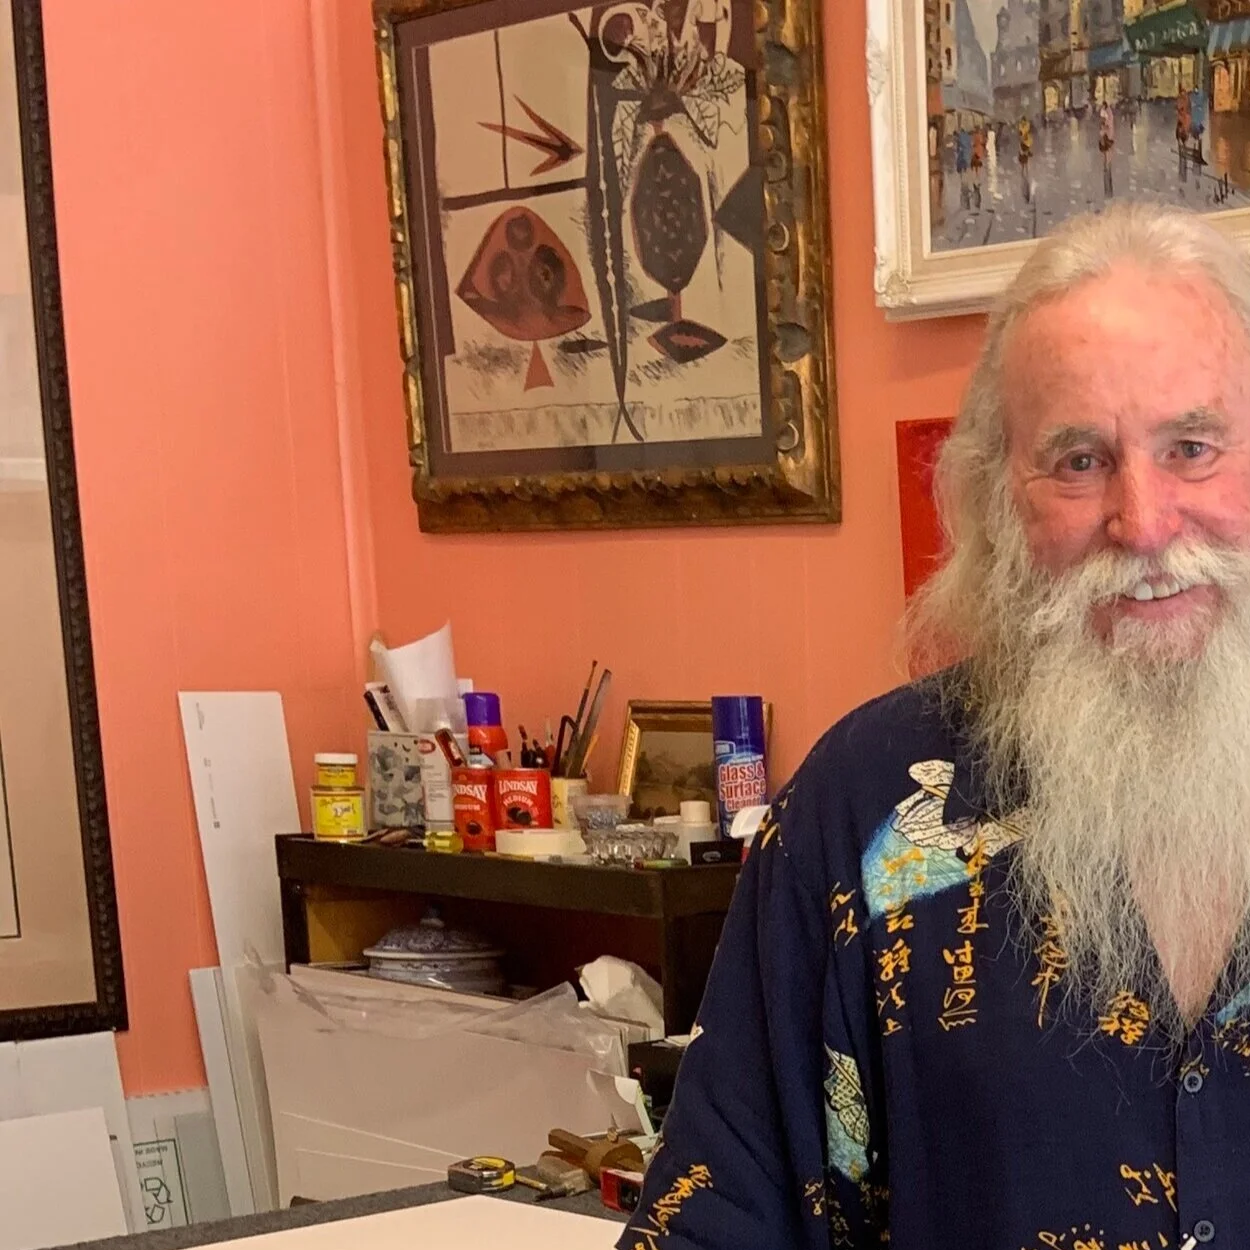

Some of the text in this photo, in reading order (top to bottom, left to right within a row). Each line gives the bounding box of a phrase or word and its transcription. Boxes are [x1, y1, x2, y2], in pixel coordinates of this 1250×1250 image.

[719, 761, 765, 782] Glass &
[452, 784, 488, 804] NDSAY
[498, 780, 538, 796] LINDSAY
[719, 777, 765, 799] Surface
